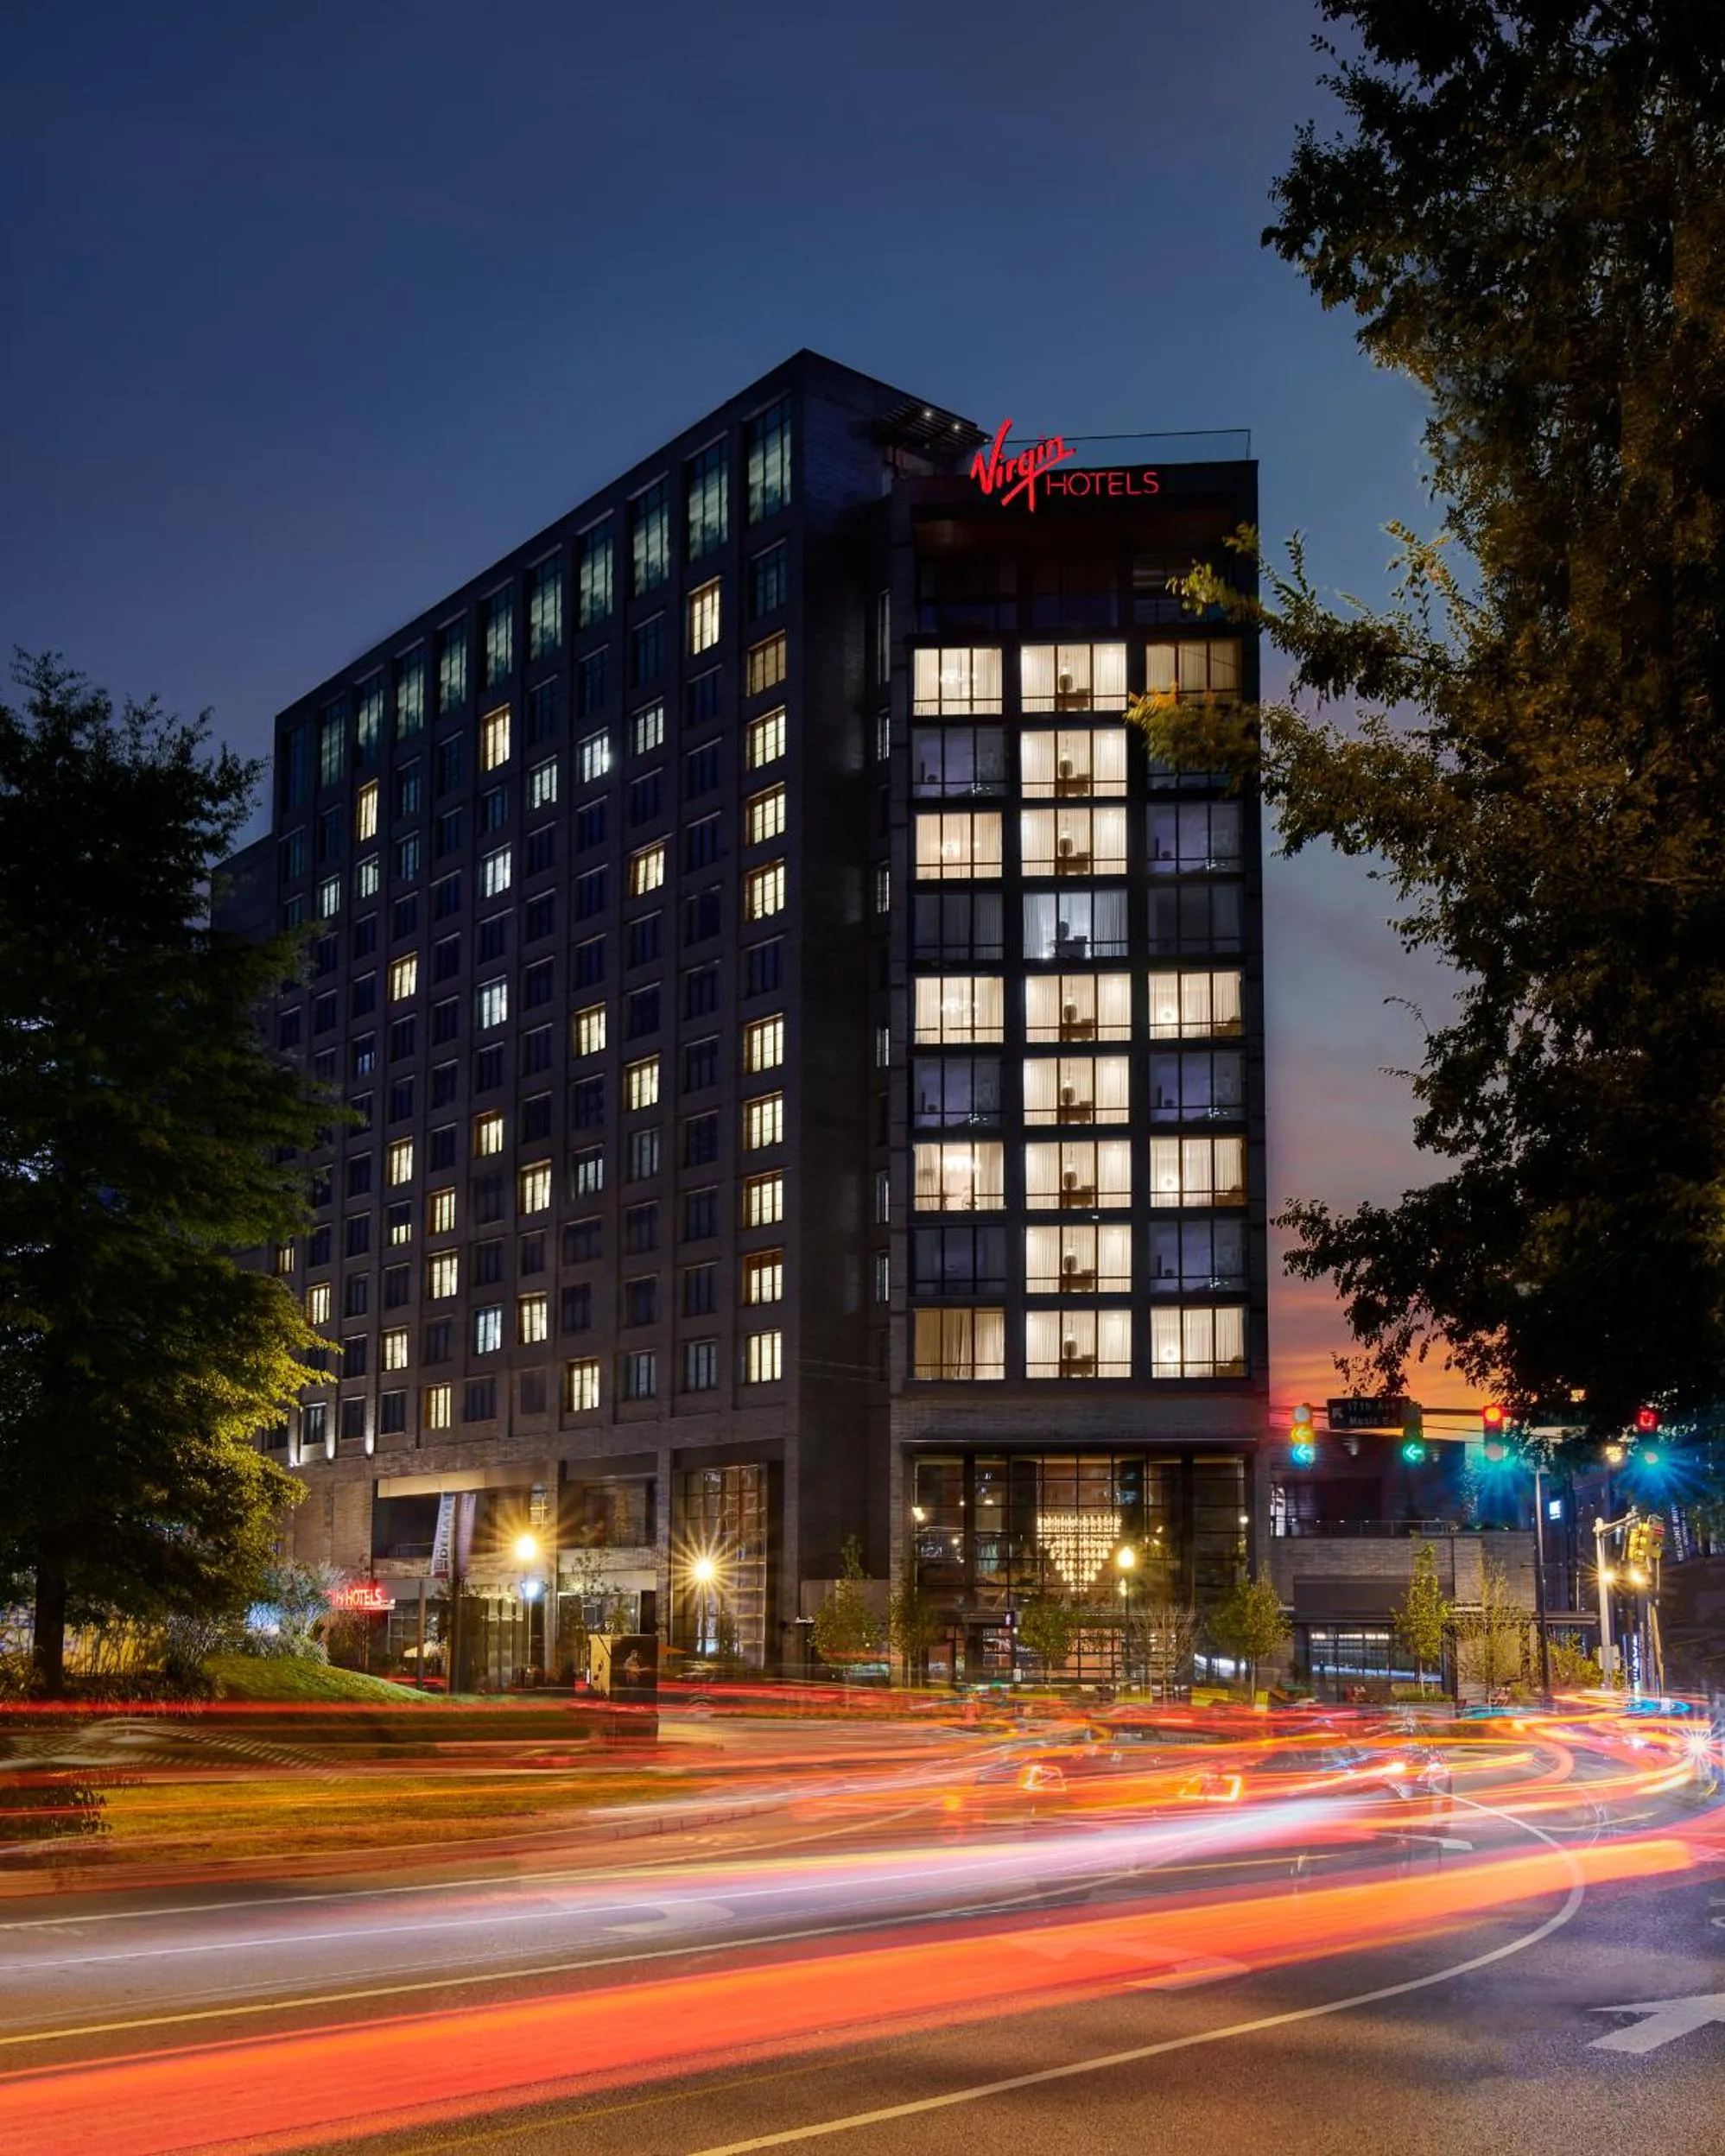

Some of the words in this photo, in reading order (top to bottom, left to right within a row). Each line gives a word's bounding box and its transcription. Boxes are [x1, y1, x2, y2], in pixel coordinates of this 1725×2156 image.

[970, 417, 1076, 512] Virgin
[1046, 472, 1159, 496] HOTELS
[346, 1588, 382, 1606] HOTELS
